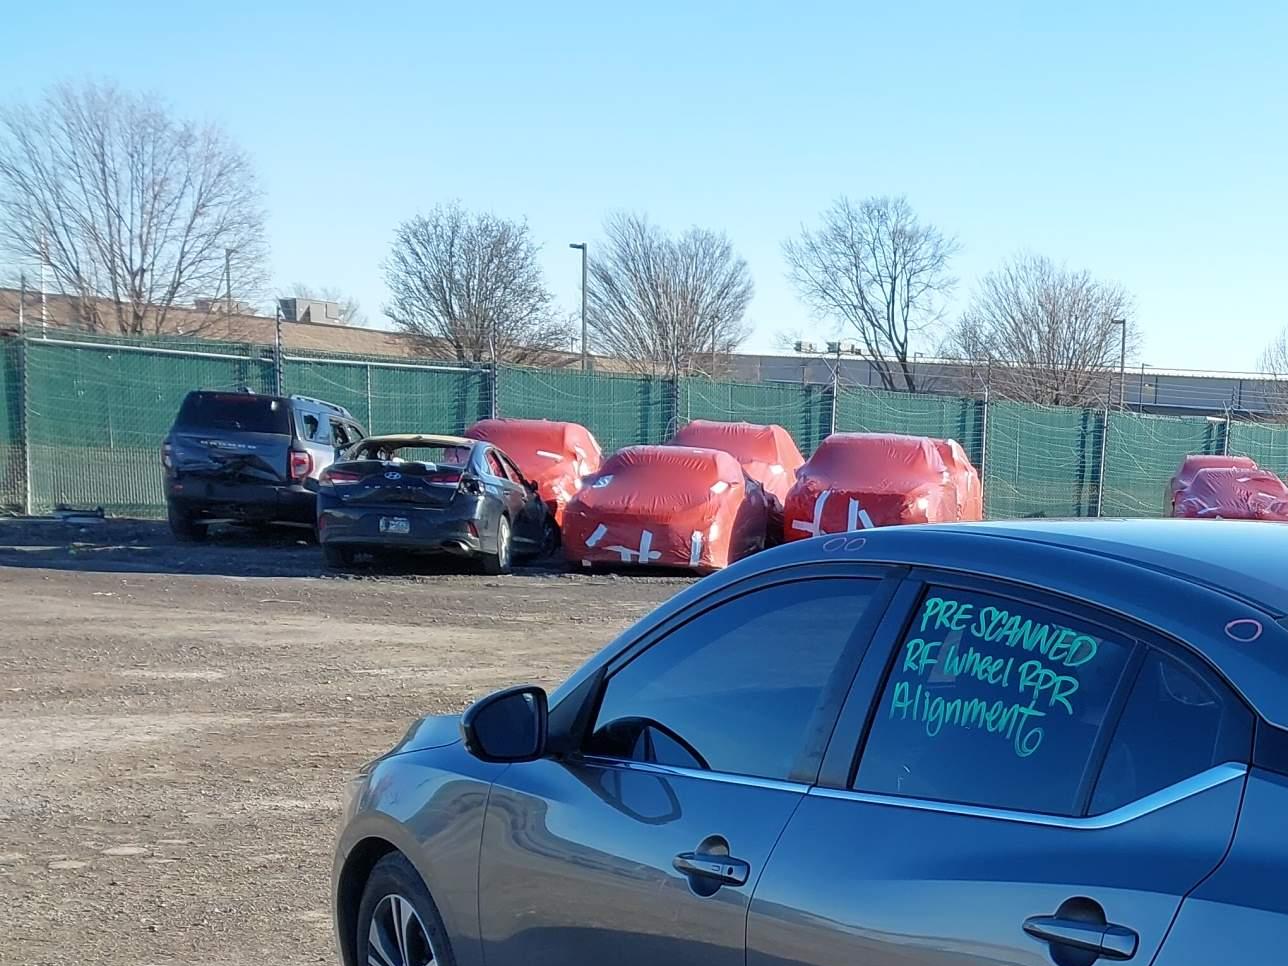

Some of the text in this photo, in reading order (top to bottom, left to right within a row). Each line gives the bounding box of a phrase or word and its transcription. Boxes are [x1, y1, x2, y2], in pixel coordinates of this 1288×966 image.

[920, 597, 1098, 667] PRE SCANNED
[902, 638, 942, 676] RF
[1017, 659, 1080, 716] RPR
